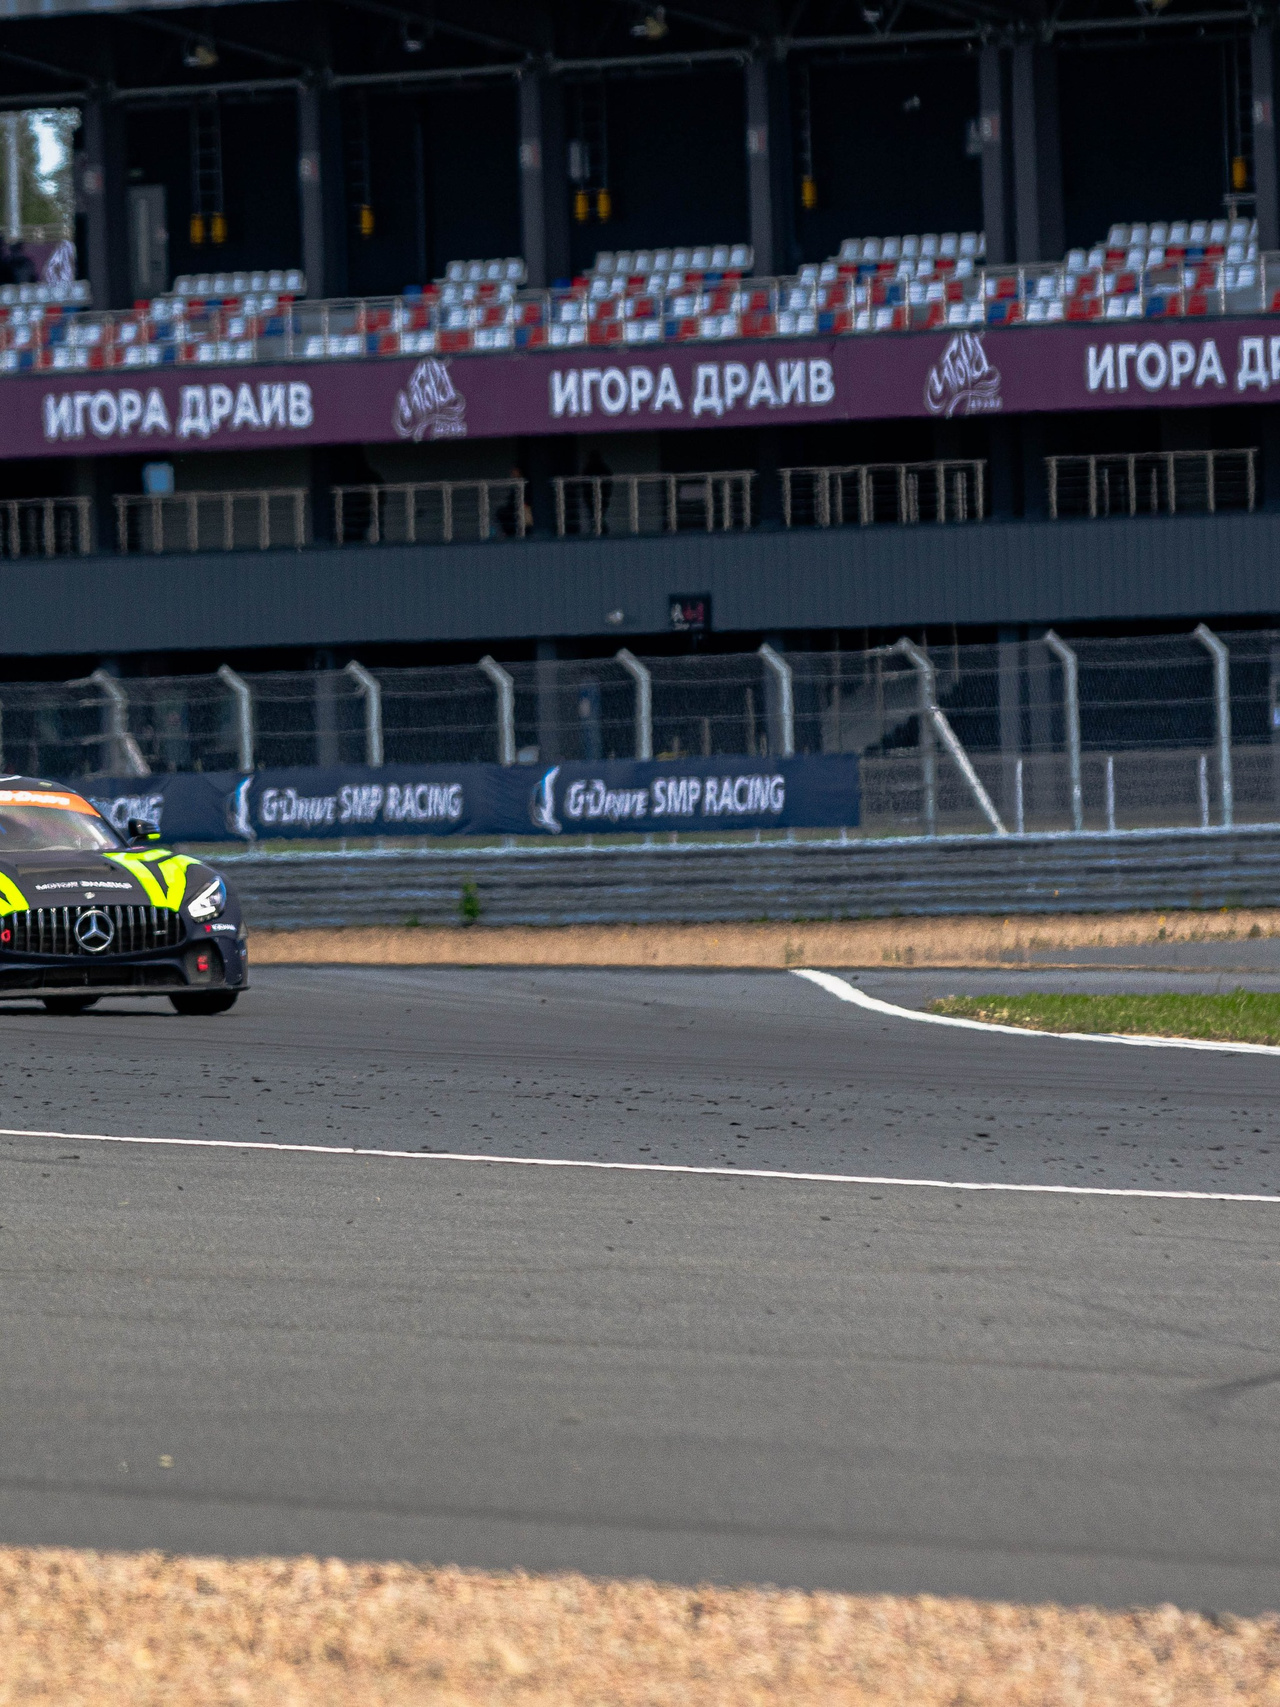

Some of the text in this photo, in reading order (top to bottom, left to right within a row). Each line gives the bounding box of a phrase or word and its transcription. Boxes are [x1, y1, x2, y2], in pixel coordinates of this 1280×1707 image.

[550, 357, 834, 416] ИГОРА ДРАЙВ
[1087, 341, 1225, 392] ИГОРА
[44, 387, 170, 441] ИГОРА
[340, 784, 381, 823] SMP
[383, 783, 463, 821] RACING
[652, 776, 701, 816] SMP
[703, 775, 785, 814] RACING
